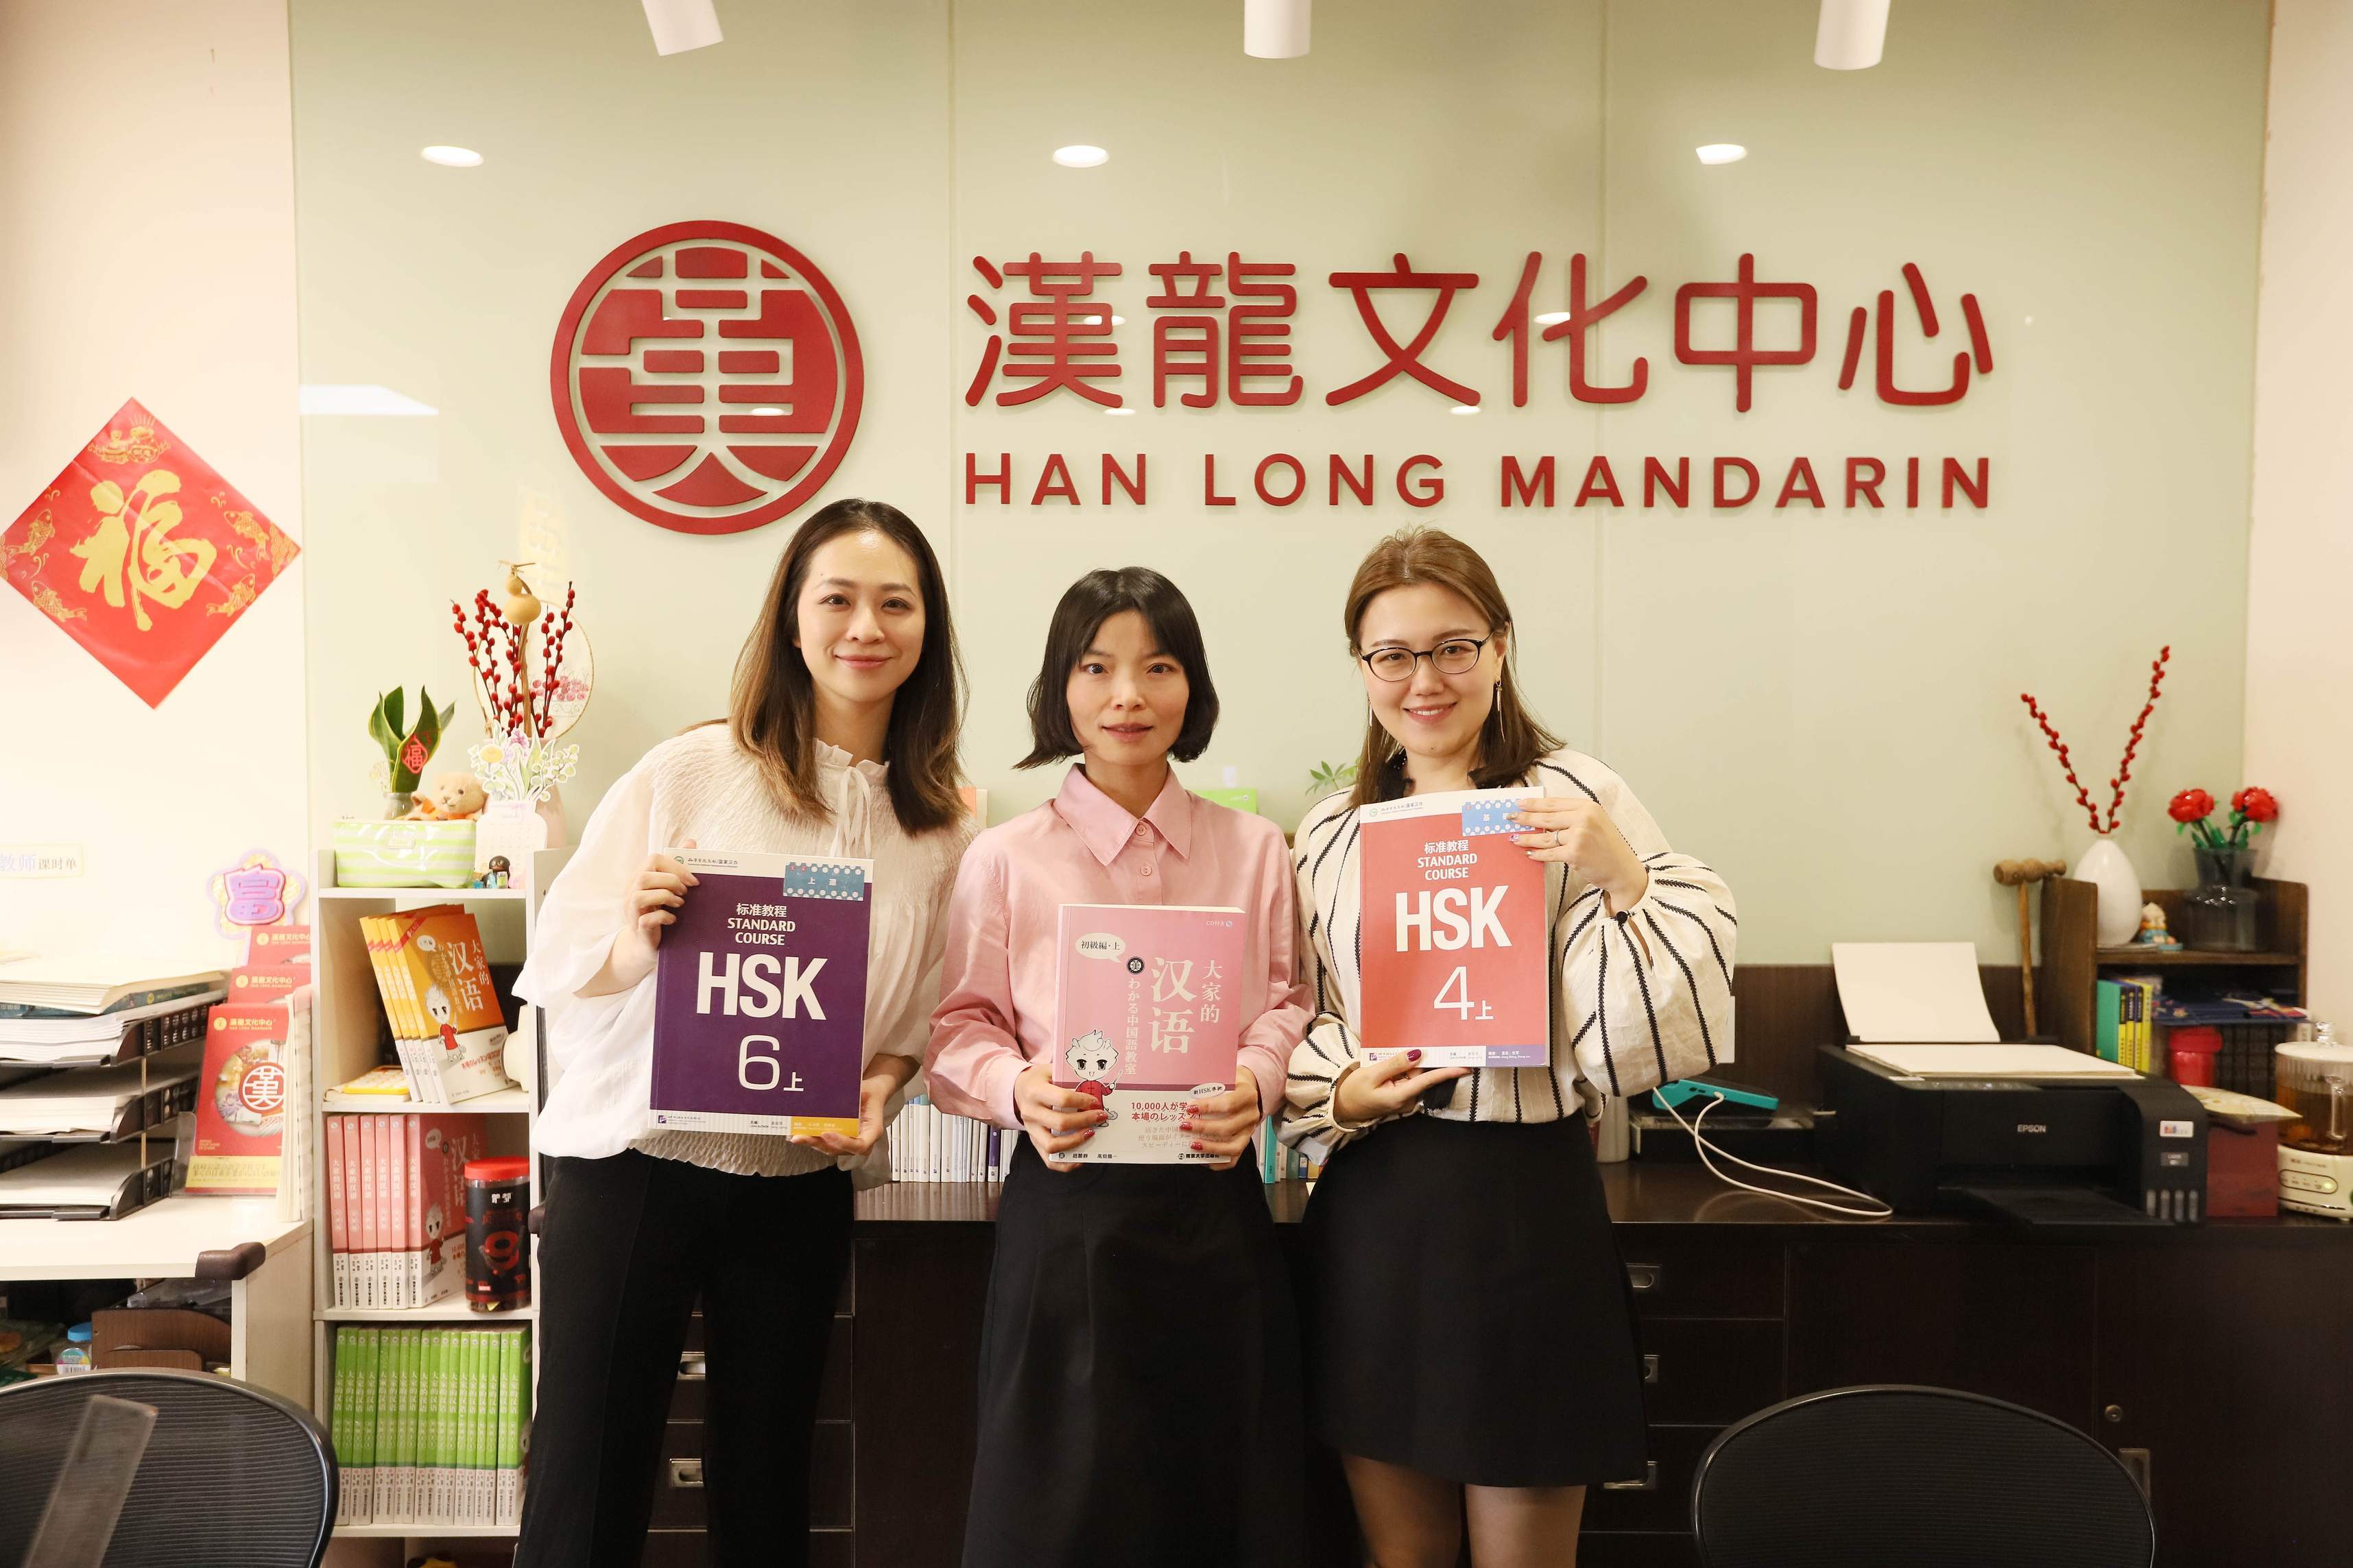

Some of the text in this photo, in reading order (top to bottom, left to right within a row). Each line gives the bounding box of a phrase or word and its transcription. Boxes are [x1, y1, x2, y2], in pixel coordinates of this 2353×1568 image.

[966, 251, 1993, 412] 漢龍文化中心
[966, 453, 1990, 507] HAN LONG MANDARIN
[70, 469, 217, 631] 福
[1418, 853, 1477, 869] STANDARD
[1424, 839, 1469, 854] 标准教程
[1424, 867, 1469, 882] COURSE
[727, 917, 796, 932] STANDARD
[735, 932, 785, 945] COURSE
[736, 902, 787, 918] 标准教程
[1396, 884, 1512, 952] HSK
[447, 941, 483, 1011] 汉语
[696, 952, 828, 1020] HSK
[1147, 957, 1197, 1053] 汉语
[1200, 960, 1223, 1024] 大家的
[1124, 978, 1140, 1075] わかる中国語教室
[2017, 1124, 2046, 1133] EPSON
